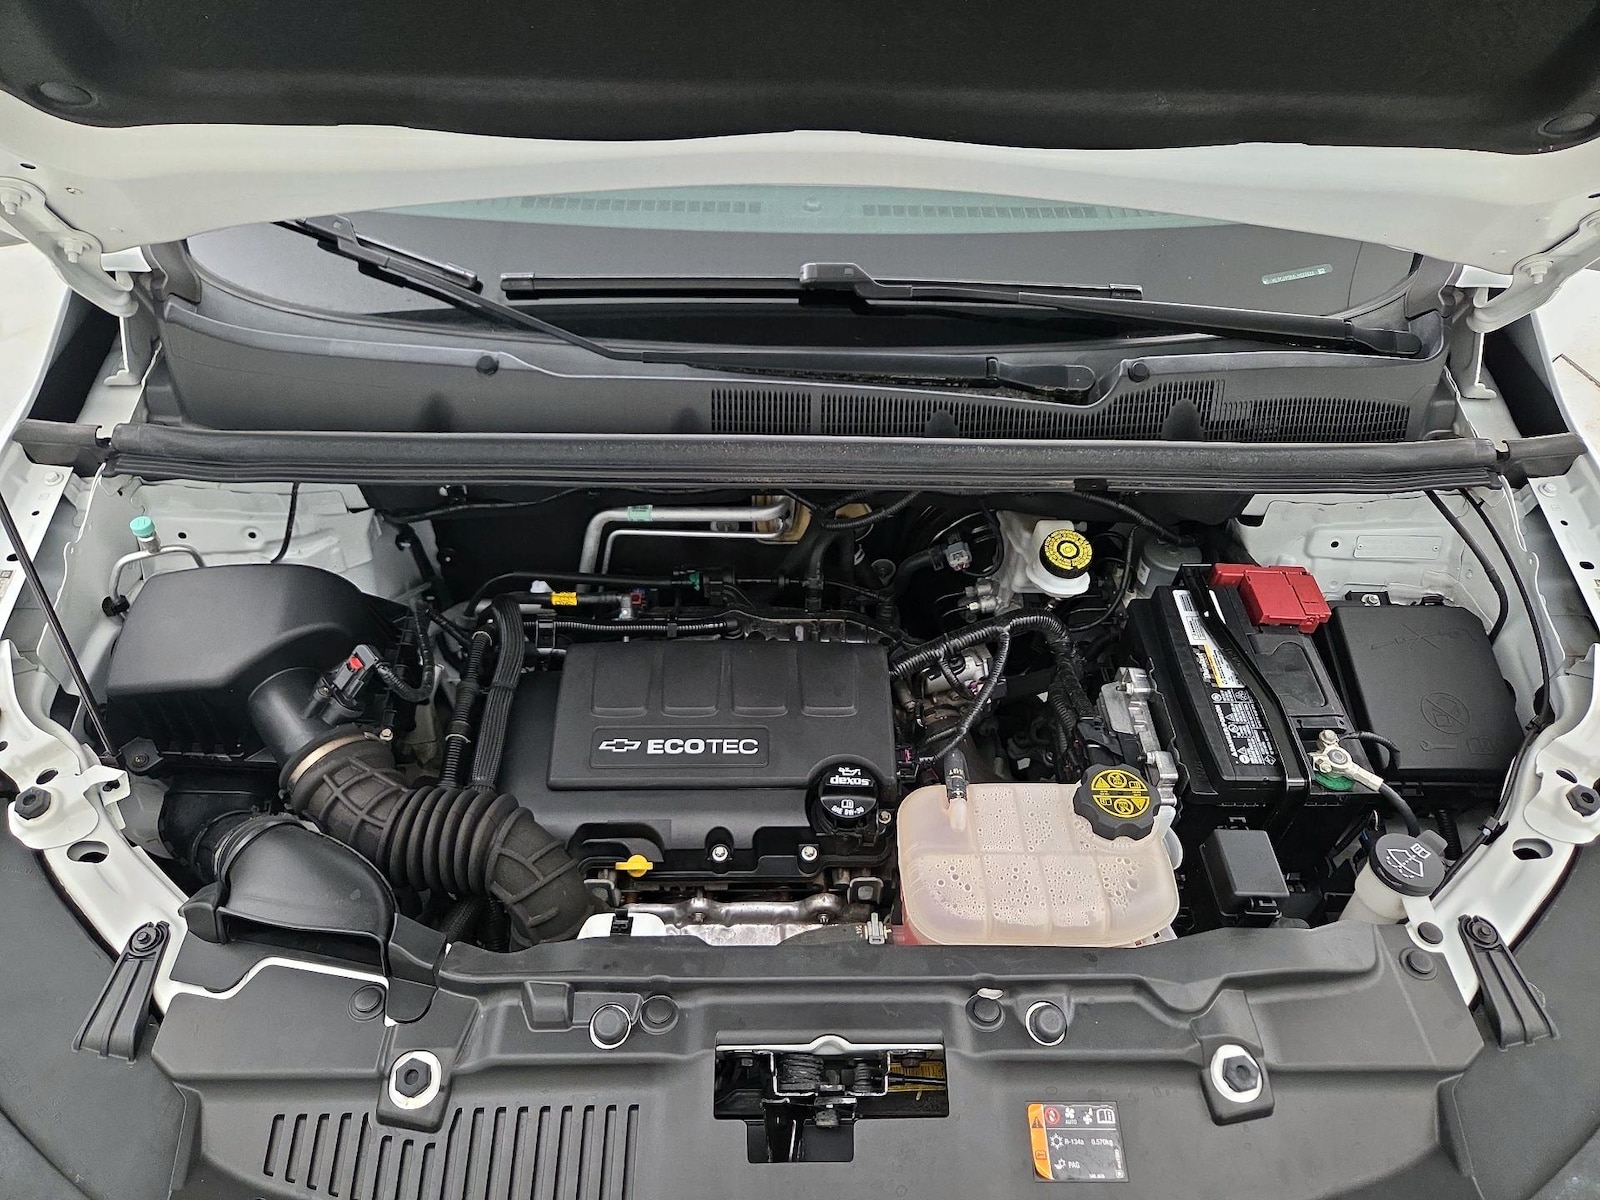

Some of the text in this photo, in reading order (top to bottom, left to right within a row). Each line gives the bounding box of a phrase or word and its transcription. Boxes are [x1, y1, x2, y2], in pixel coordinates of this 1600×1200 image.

[646, 738, 760, 756] ECOTEC
[829, 775, 871, 786] dexos
[831, 805, 844, 816] SAE
[1064, 1138, 1114, 1147] R-134a 0.570kg
[1068, 1161, 1081, 1169] PAG
